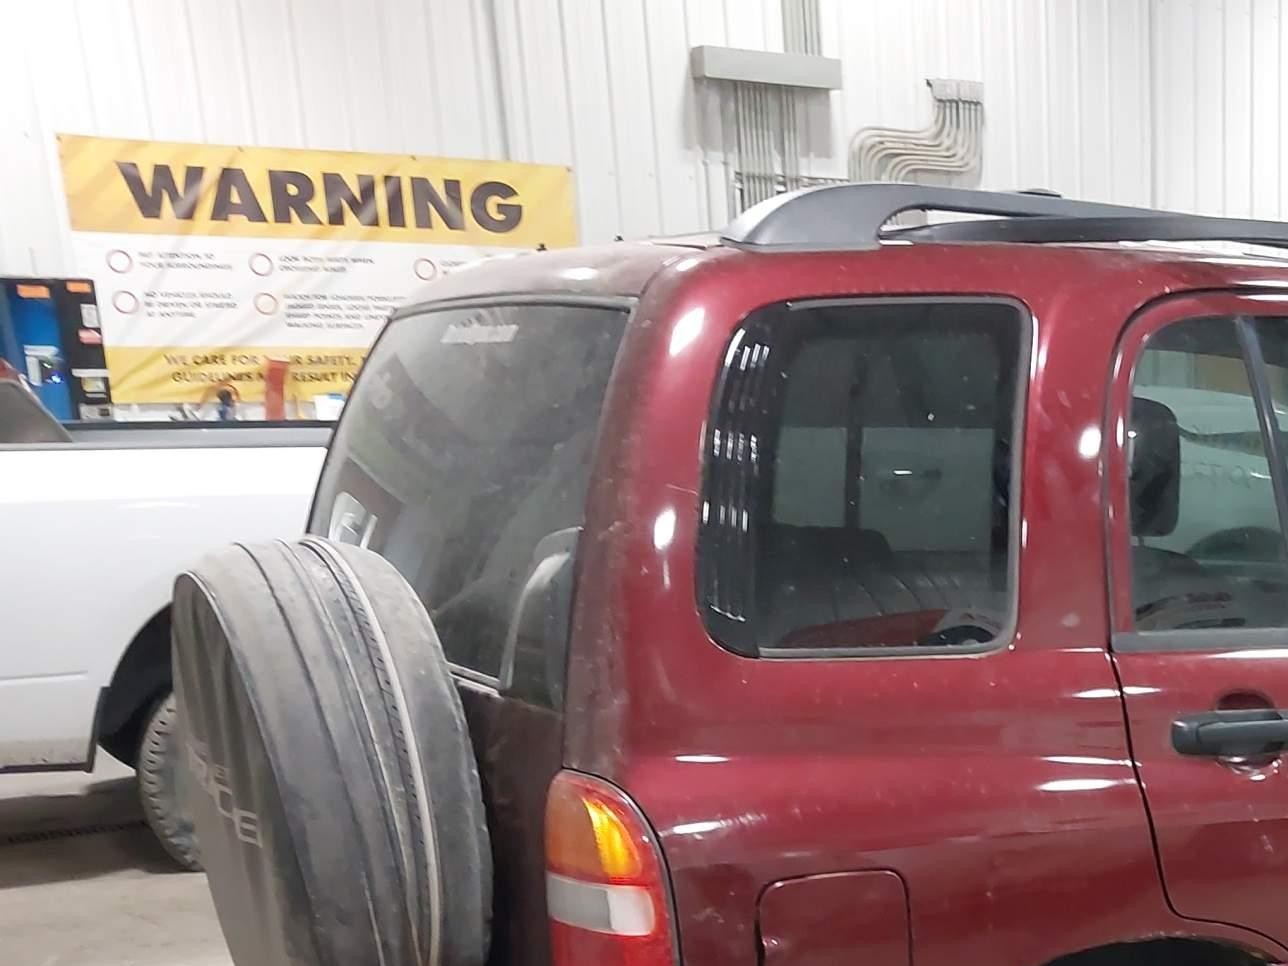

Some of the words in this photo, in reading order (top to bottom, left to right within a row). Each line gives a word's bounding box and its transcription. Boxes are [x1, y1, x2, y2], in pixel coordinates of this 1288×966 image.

[115, 160, 523, 233] WARNING
[192, 354, 226, 366] CARE
[231, 355, 259, 366] FOR
